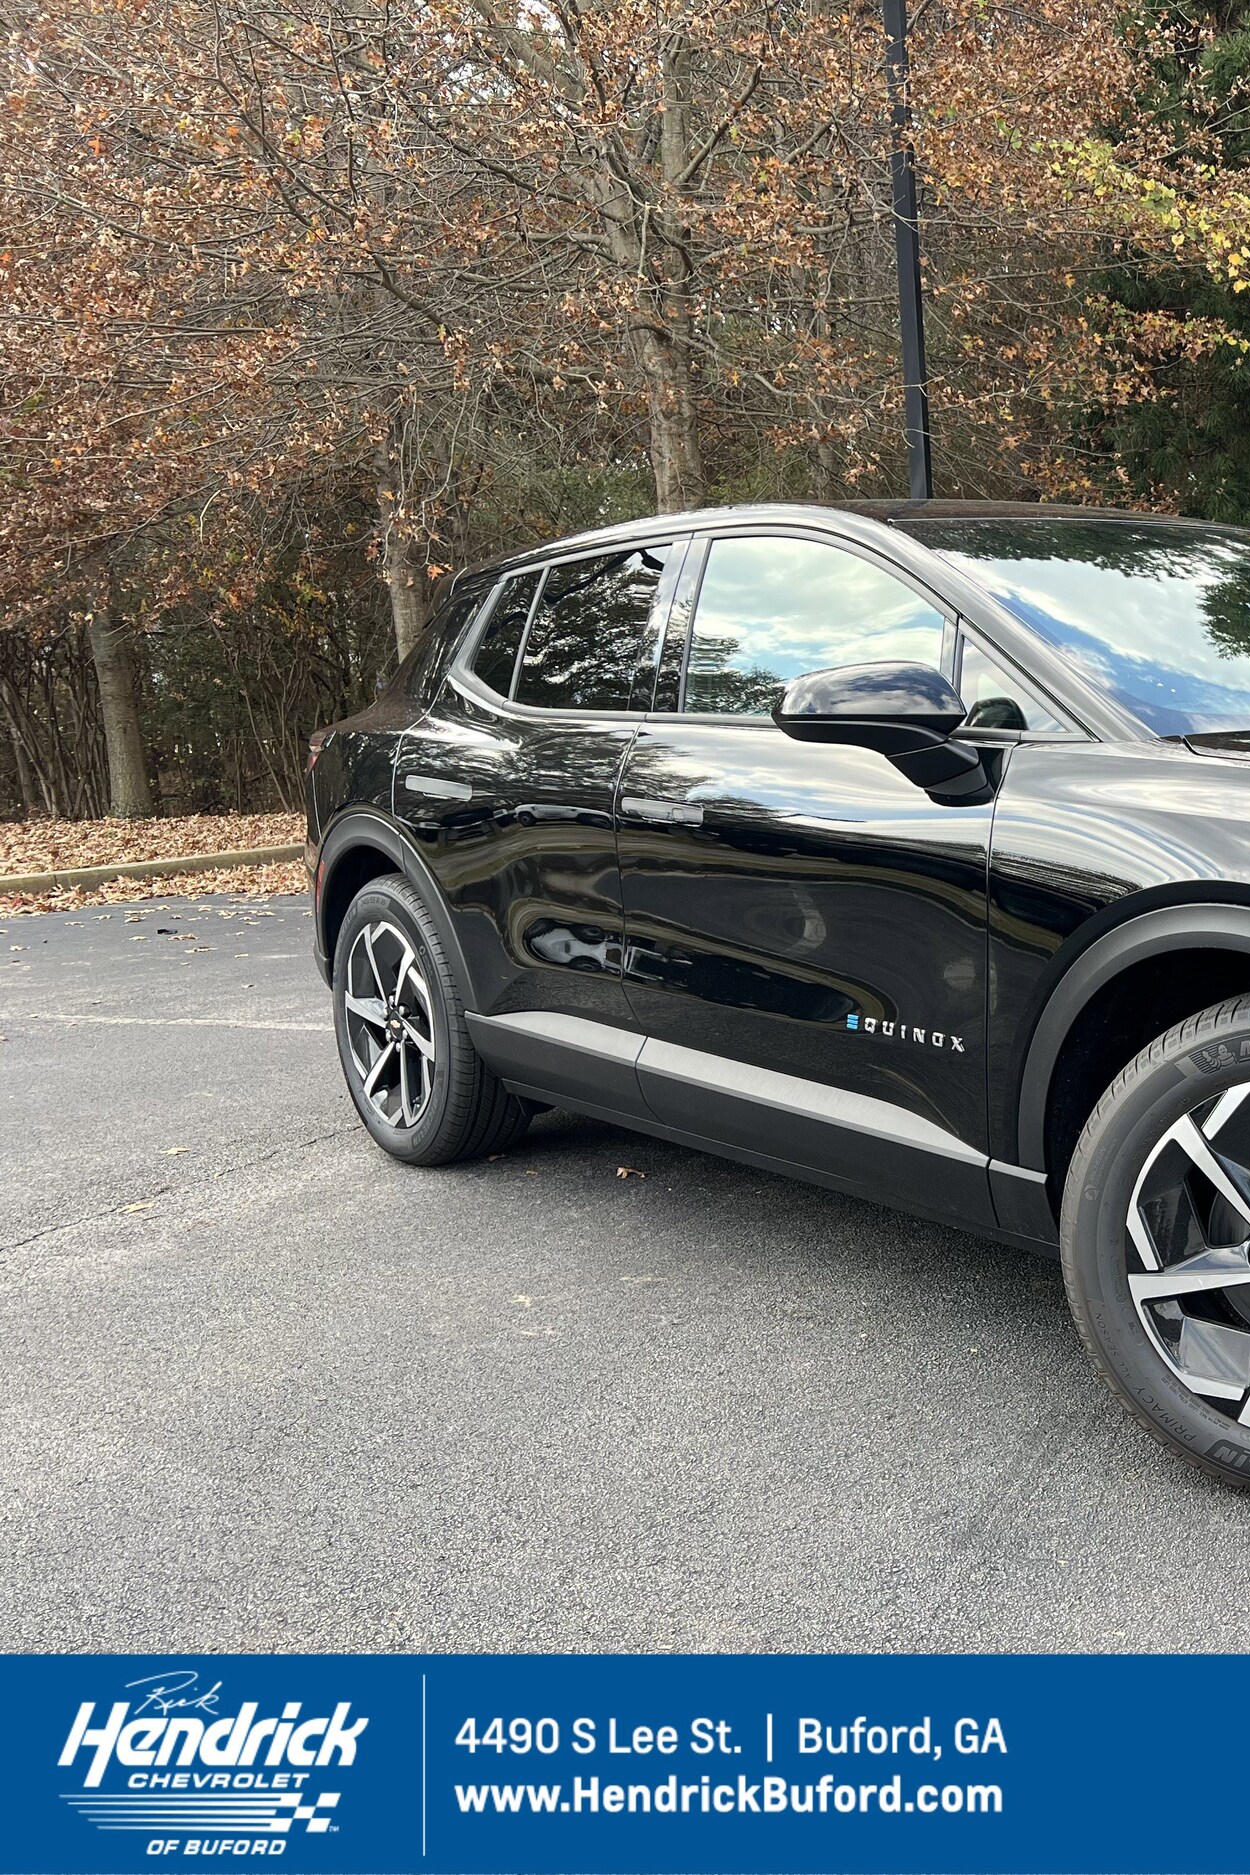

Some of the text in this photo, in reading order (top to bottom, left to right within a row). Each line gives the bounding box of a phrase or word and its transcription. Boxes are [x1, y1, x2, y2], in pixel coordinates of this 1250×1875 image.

[846, 1013, 966, 1053] EQUINOX
[1095, 1312, 1120, 1358] SEASON
[1117, 1360, 1132, 1380] ALL
[1133, 1386, 1198, 1443] PRIMACY
